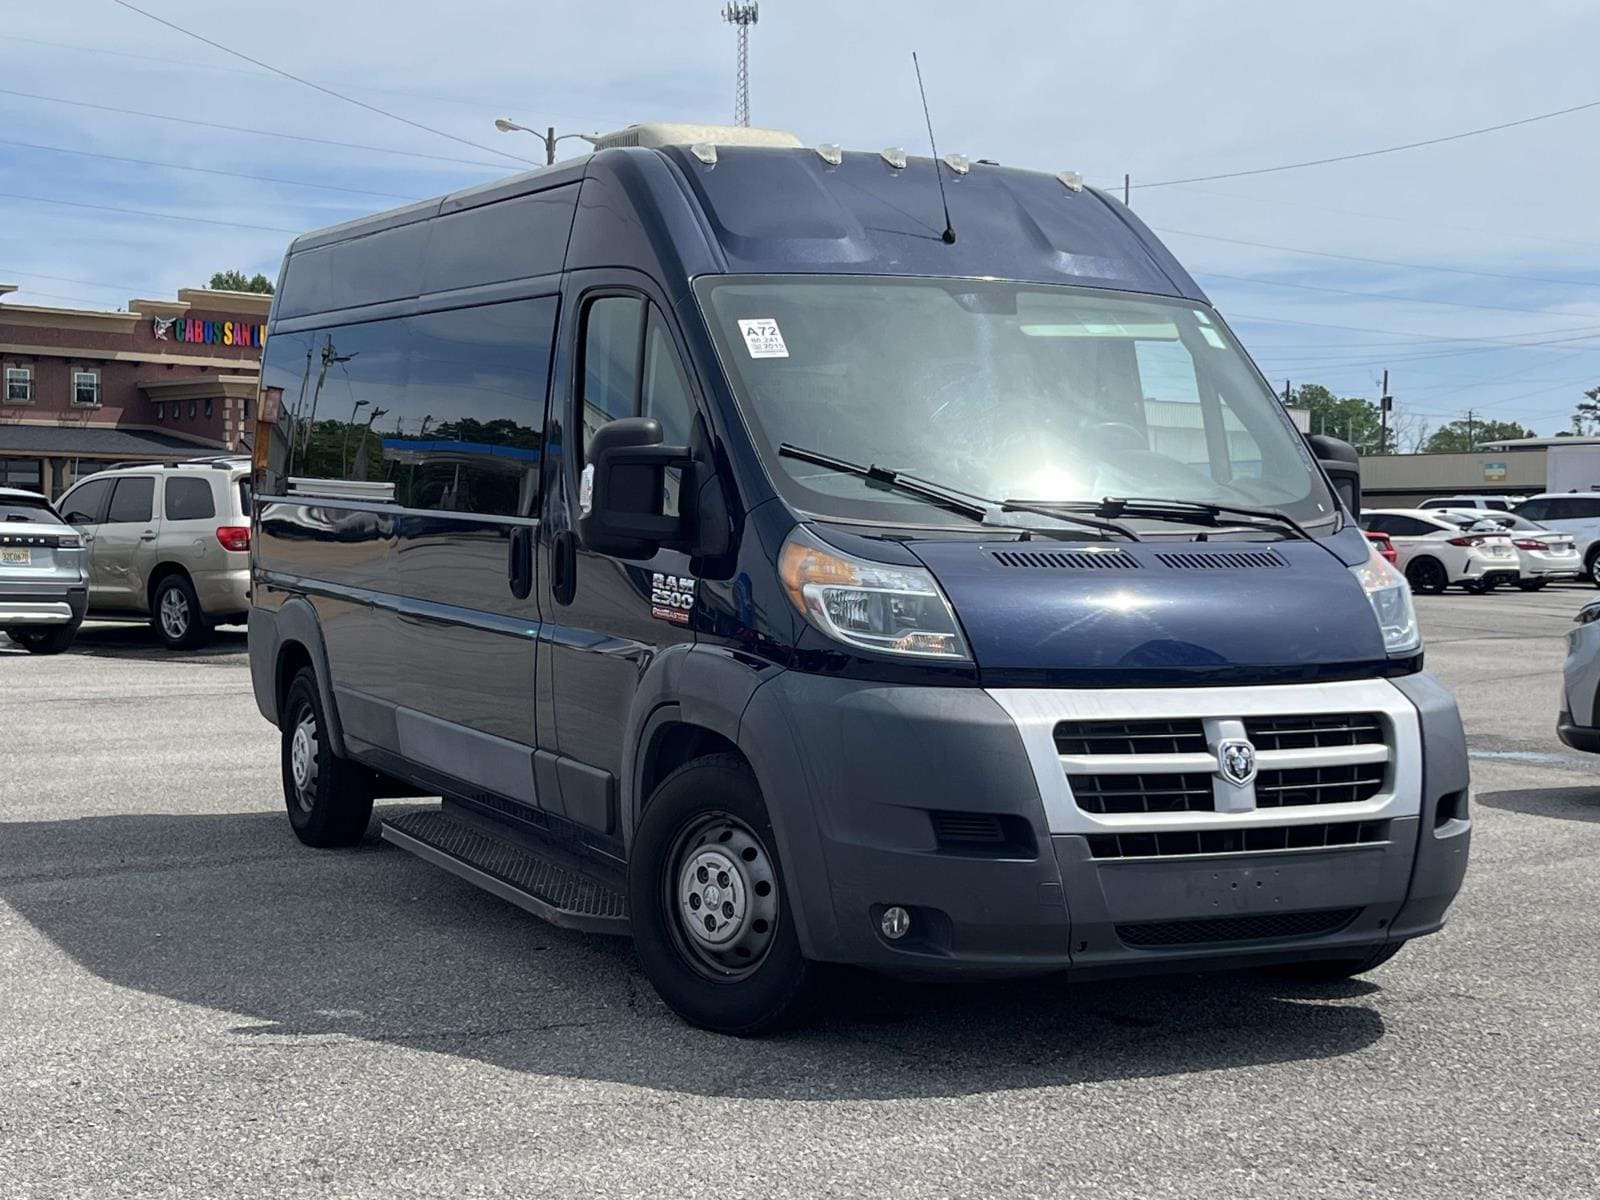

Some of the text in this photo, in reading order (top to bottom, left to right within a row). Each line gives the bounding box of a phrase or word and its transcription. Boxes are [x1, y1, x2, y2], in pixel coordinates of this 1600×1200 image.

[175, 319, 222, 344] CABOS
[224, 320, 251, 346] SAN
[747, 326, 778, 337] A72
[652, 573, 695, 594] RAM
